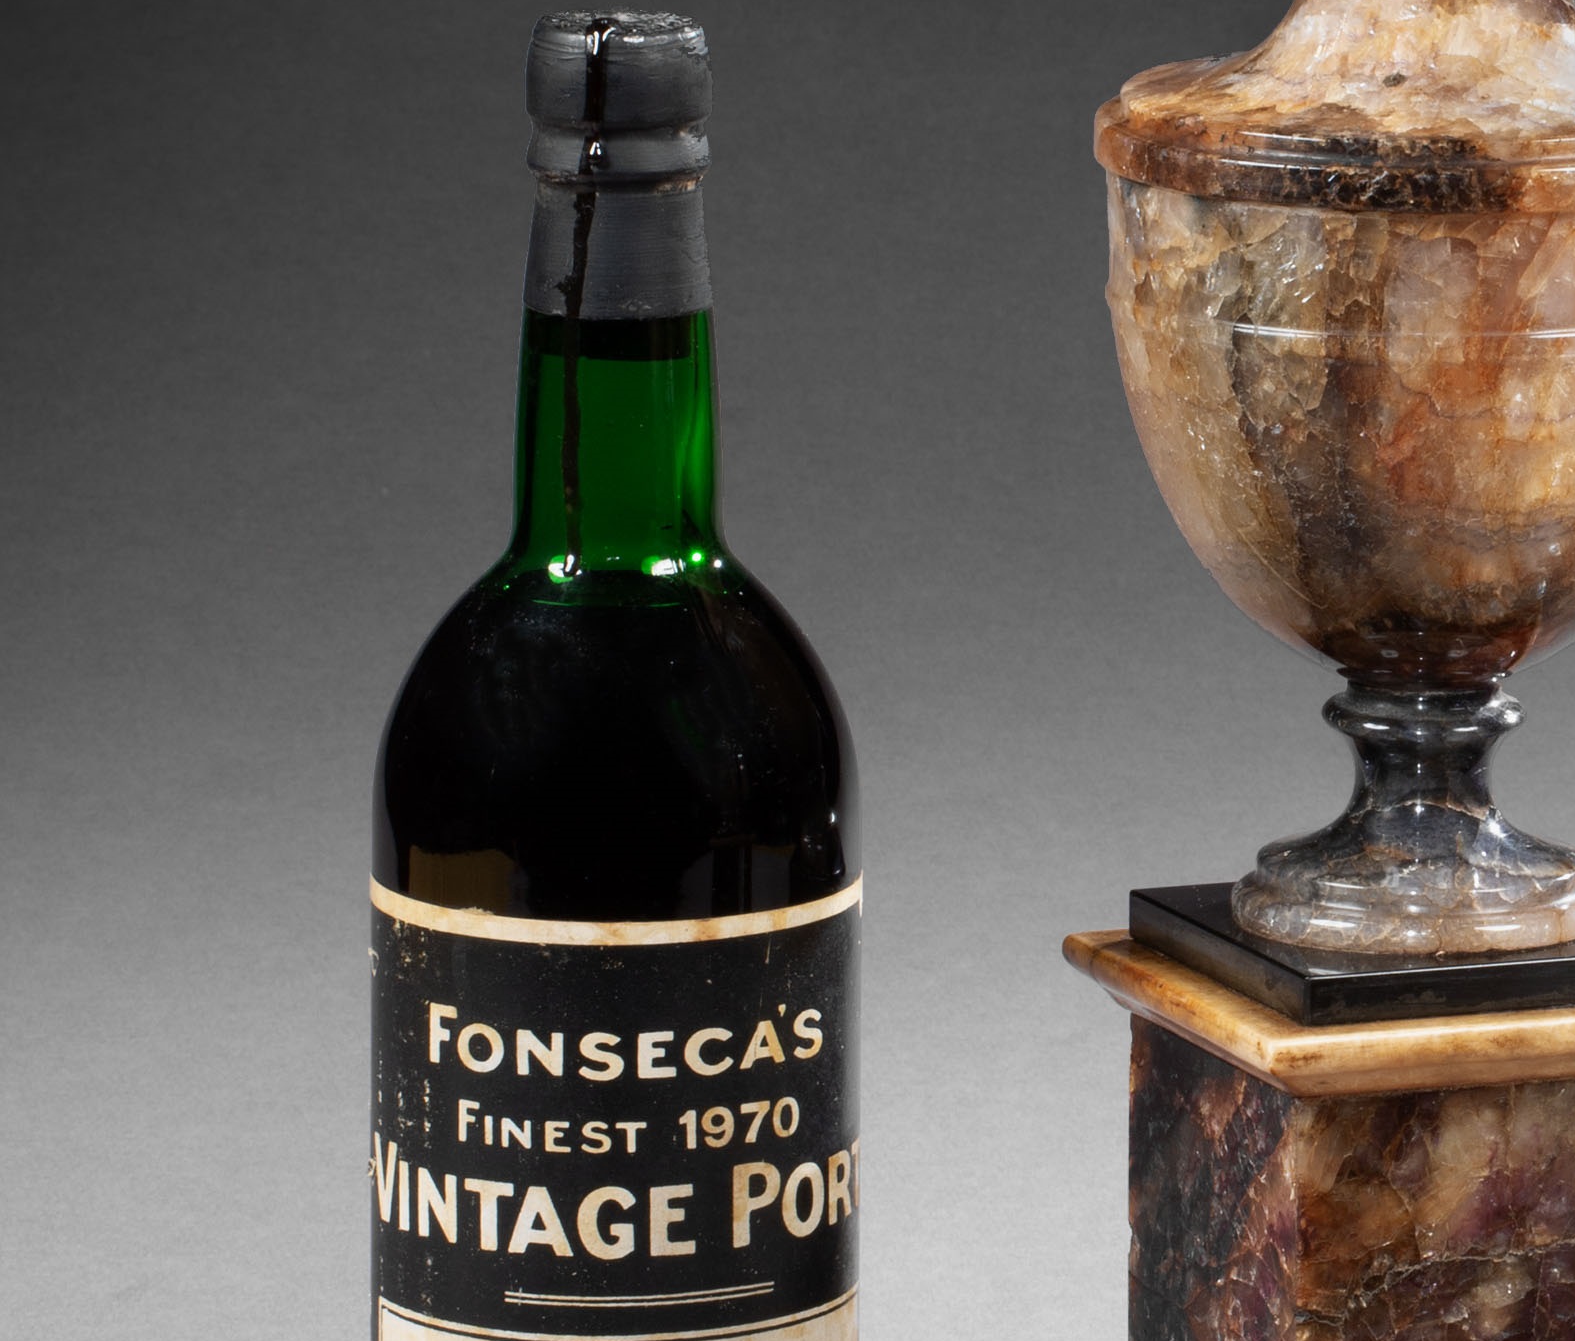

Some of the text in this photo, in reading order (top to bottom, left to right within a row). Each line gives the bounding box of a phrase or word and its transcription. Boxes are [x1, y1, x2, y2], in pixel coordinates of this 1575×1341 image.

[428, 1002, 824, 1082] FONSECA'S
[457, 1096, 801, 1154] FINEST 1970
[374, 1132, 697, 1260] VINTAGE
